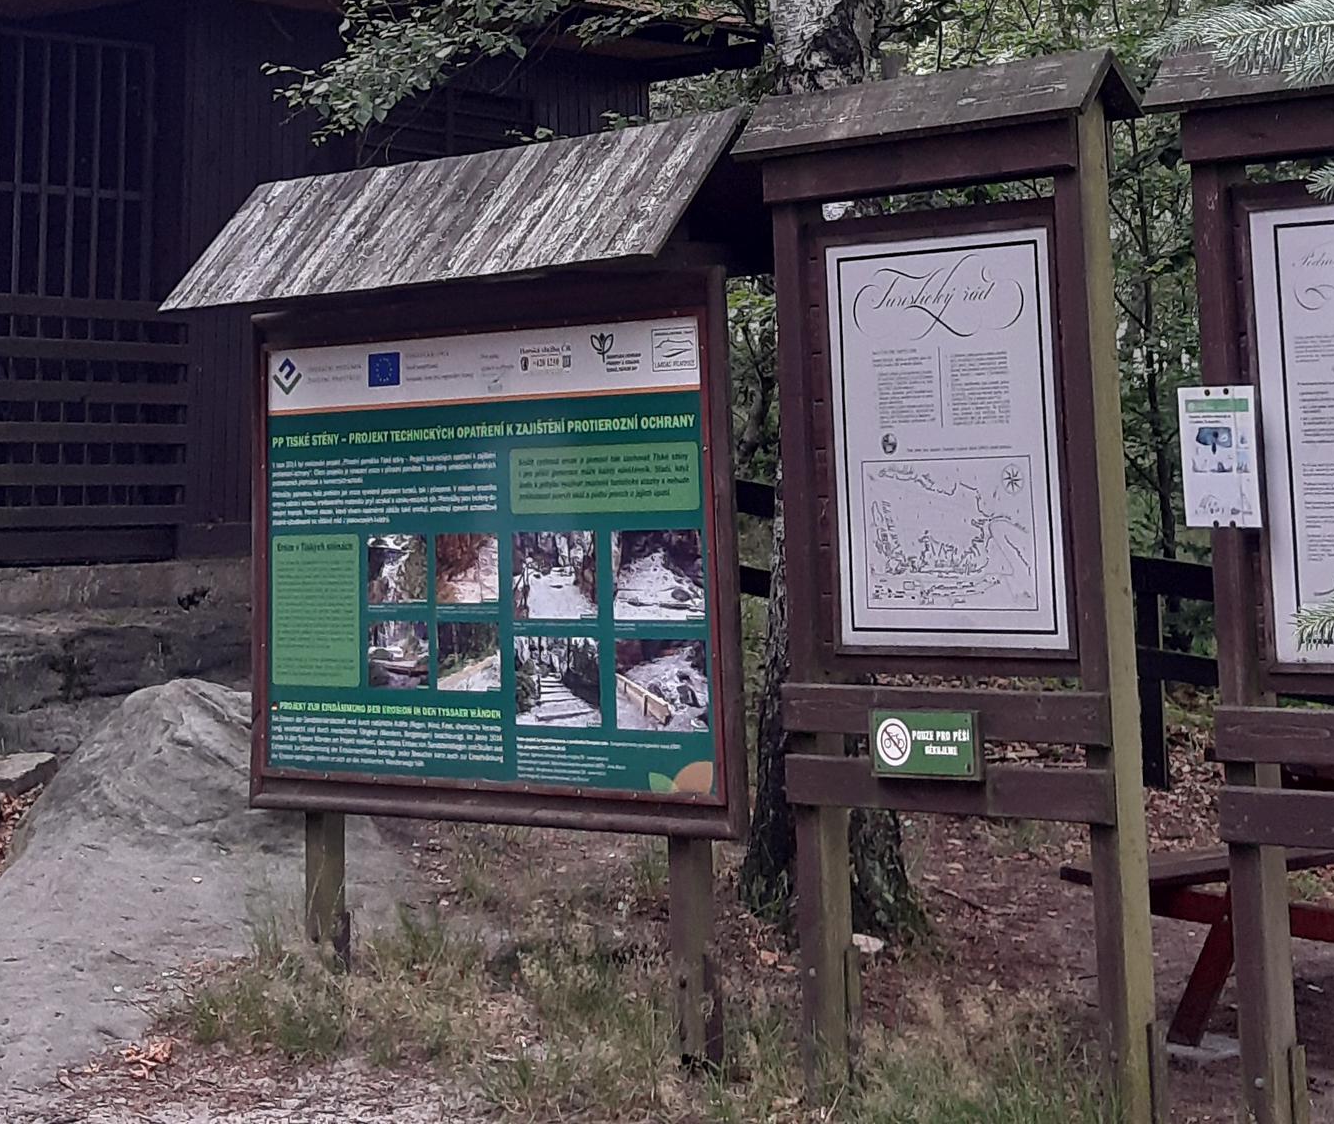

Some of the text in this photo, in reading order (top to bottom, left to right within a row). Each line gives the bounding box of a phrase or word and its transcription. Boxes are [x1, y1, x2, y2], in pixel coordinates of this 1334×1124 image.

[272, 436, 284, 448] PP
[286, 432, 310, 447] TISKÉ
[349, 430, 389, 444] PROJEKT
[390, 425, 455, 442] TECHNICKÝCH
[456, 420, 504, 438] OPATŘENÍ
[506, 423, 514, 436] K
[567, 414, 638, 433] PROTIEROZNÍ
[641, 414, 695, 429] OCHRANY
[912, 729, 970, 742] POUZE PRO PĚŠÍ
